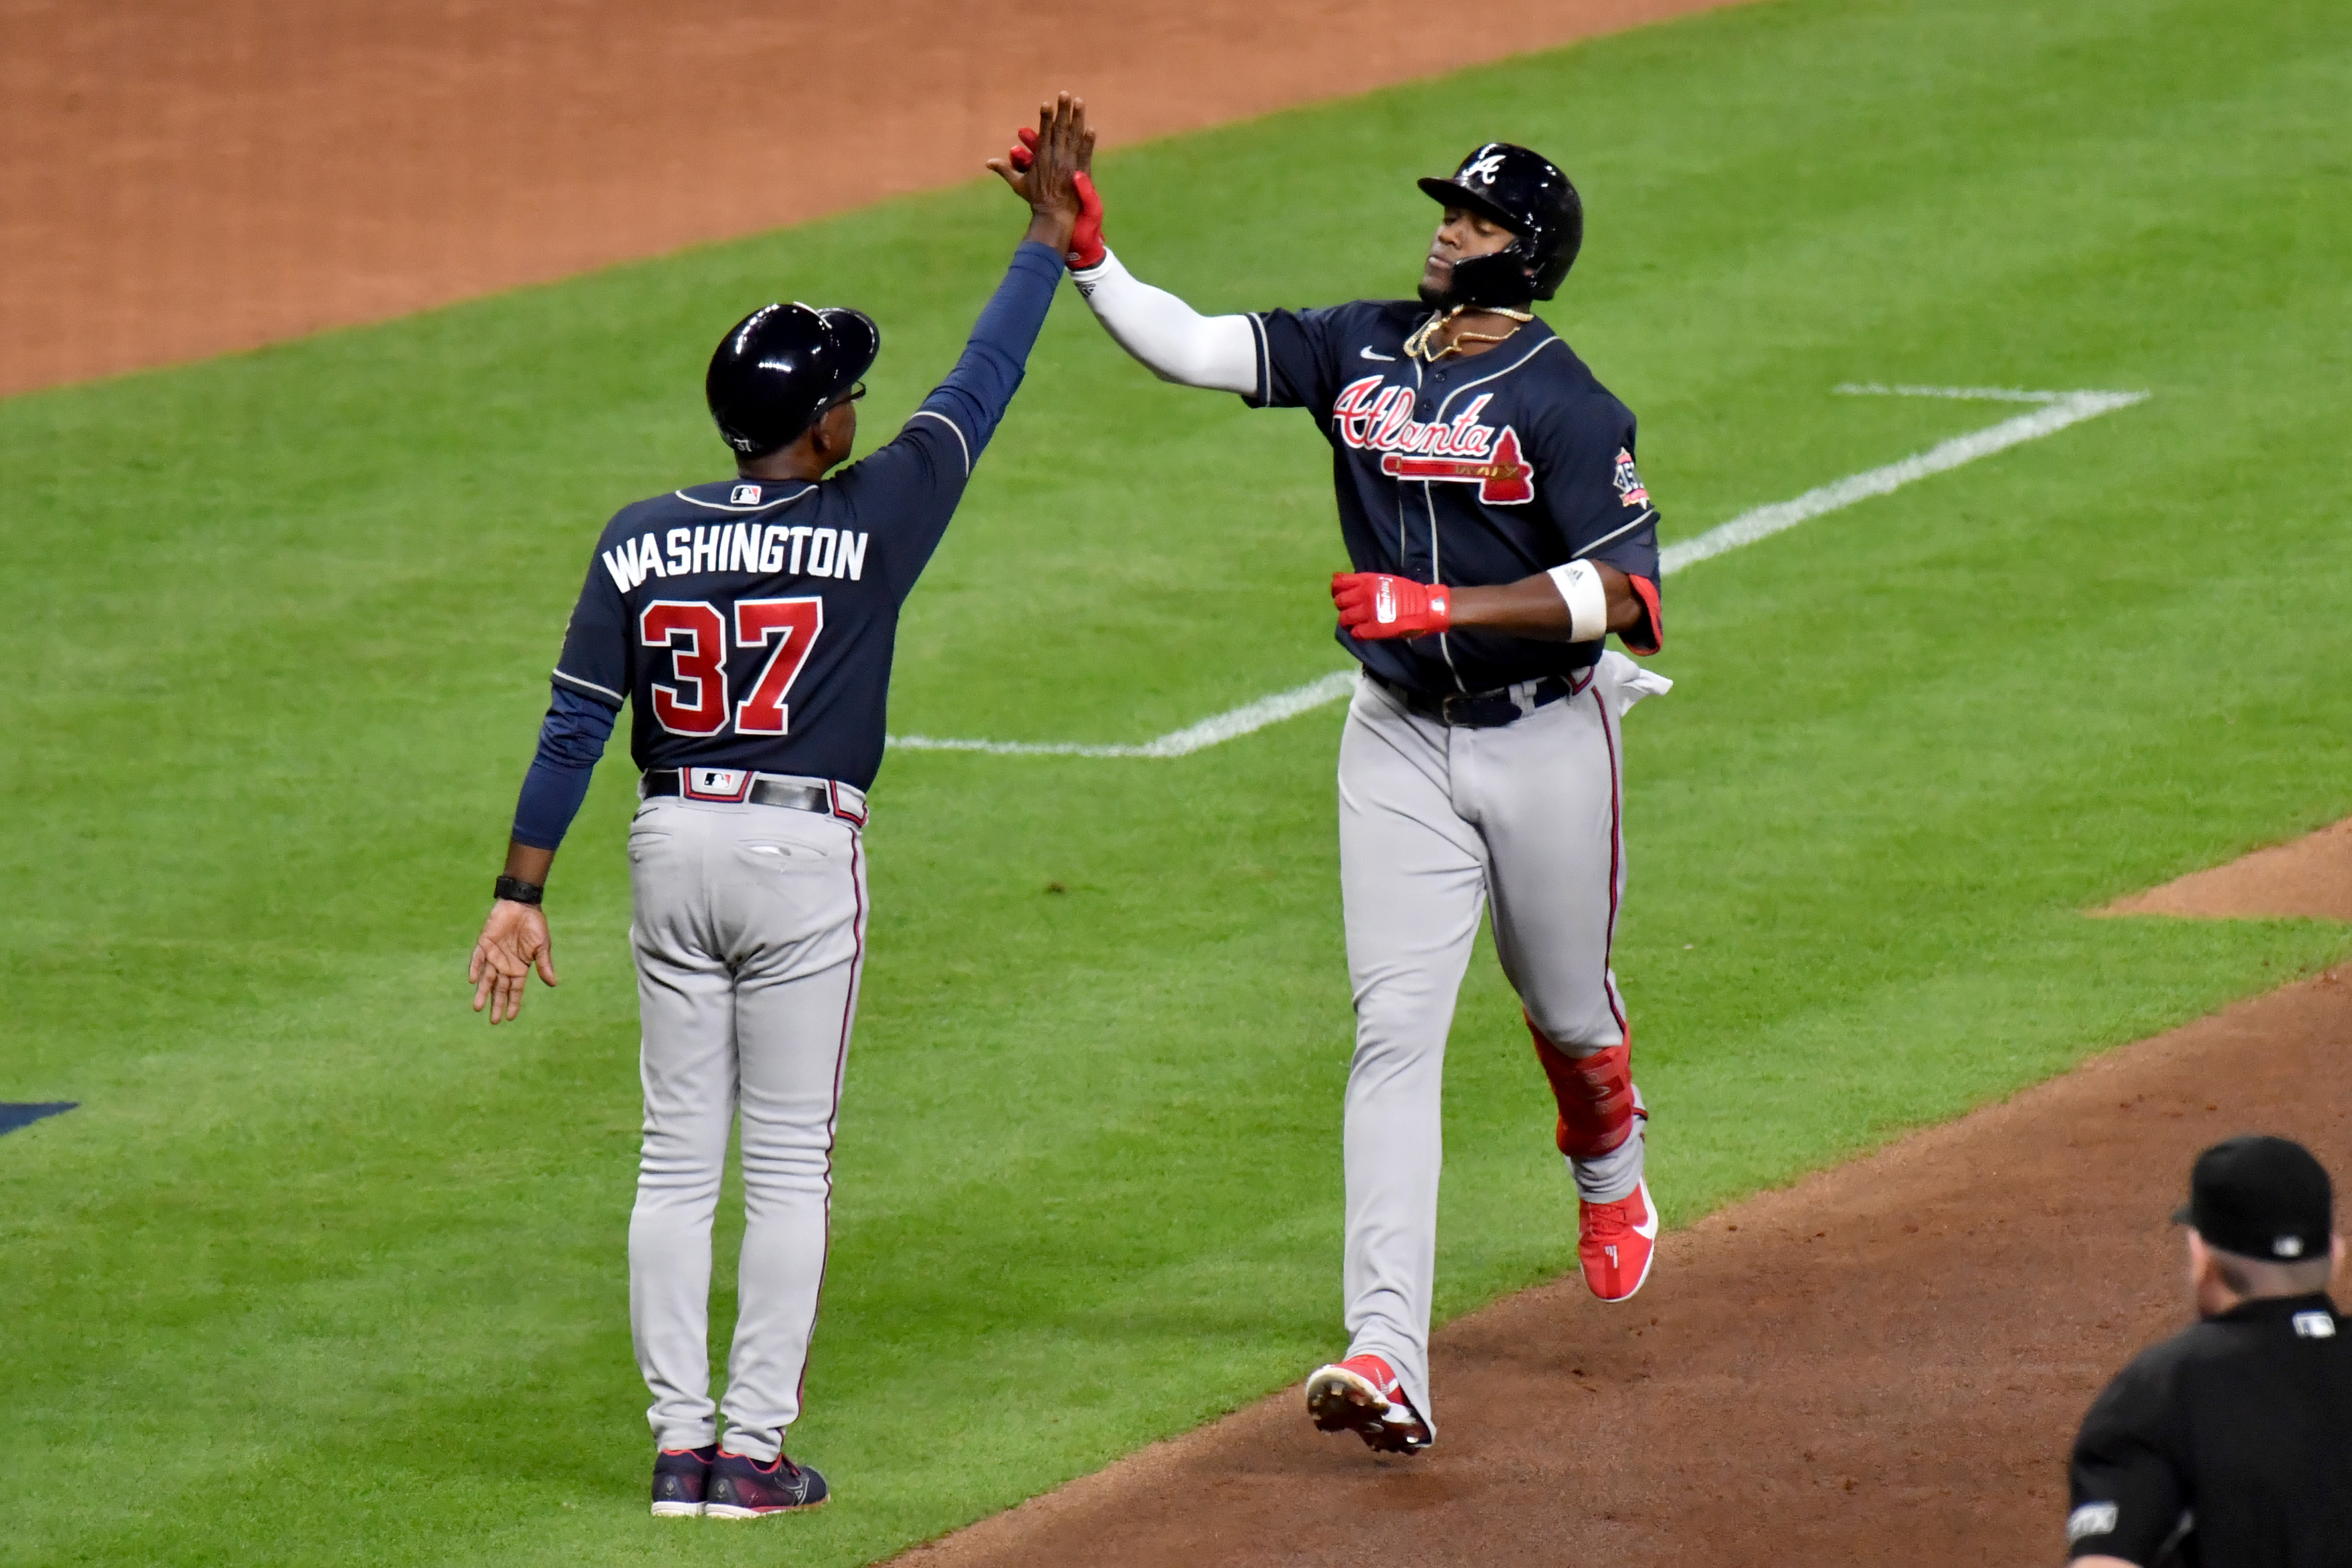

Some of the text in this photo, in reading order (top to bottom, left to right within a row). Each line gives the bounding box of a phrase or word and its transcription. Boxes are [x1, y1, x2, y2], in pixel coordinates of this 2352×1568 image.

[1462, 155, 1507, 185] A
[1333, 374, 1495, 457] Atlanta
[602, 522, 868, 594] WASHINGTON
[640, 596, 823, 737] 37
